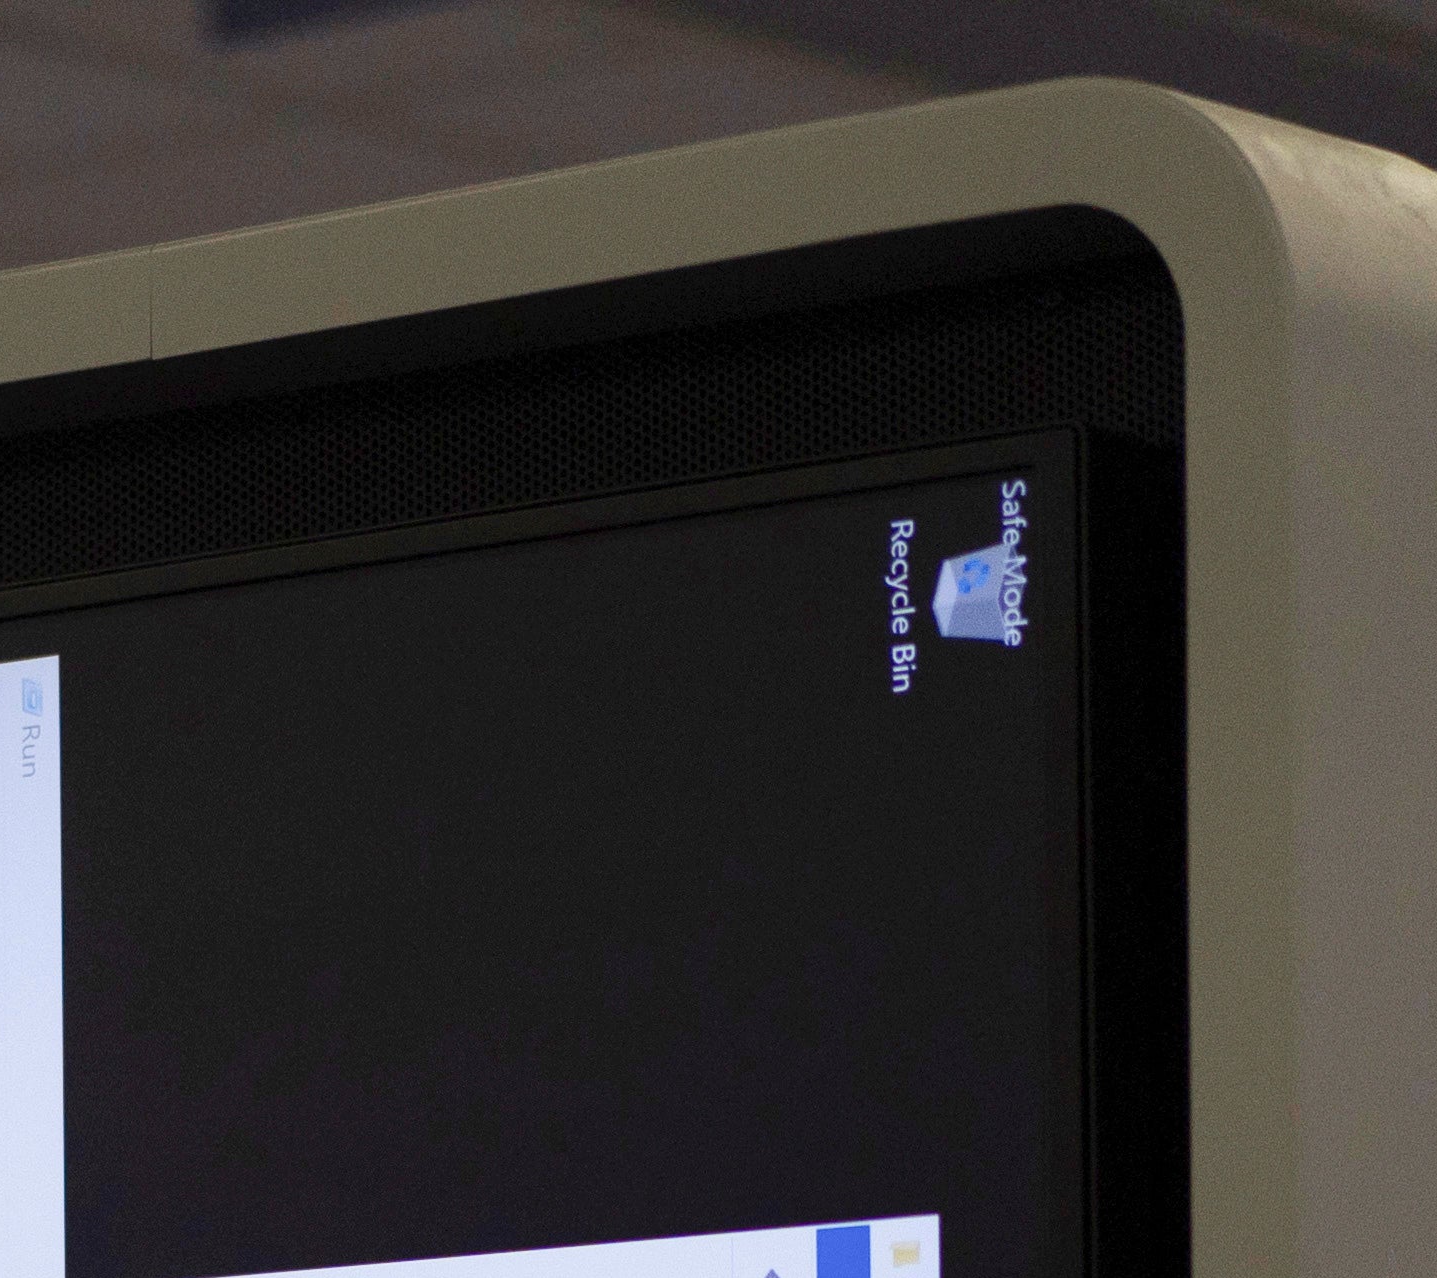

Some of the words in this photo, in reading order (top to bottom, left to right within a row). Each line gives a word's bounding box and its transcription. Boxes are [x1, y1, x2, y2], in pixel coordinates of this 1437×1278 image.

[1000, 480, 1027, 546] Safe
[884, 519, 916, 635] Recycle
[1001, 554, 1026, 647] Mode
[890, 644, 917, 694] Bin
[19, 723, 43, 780] Run
